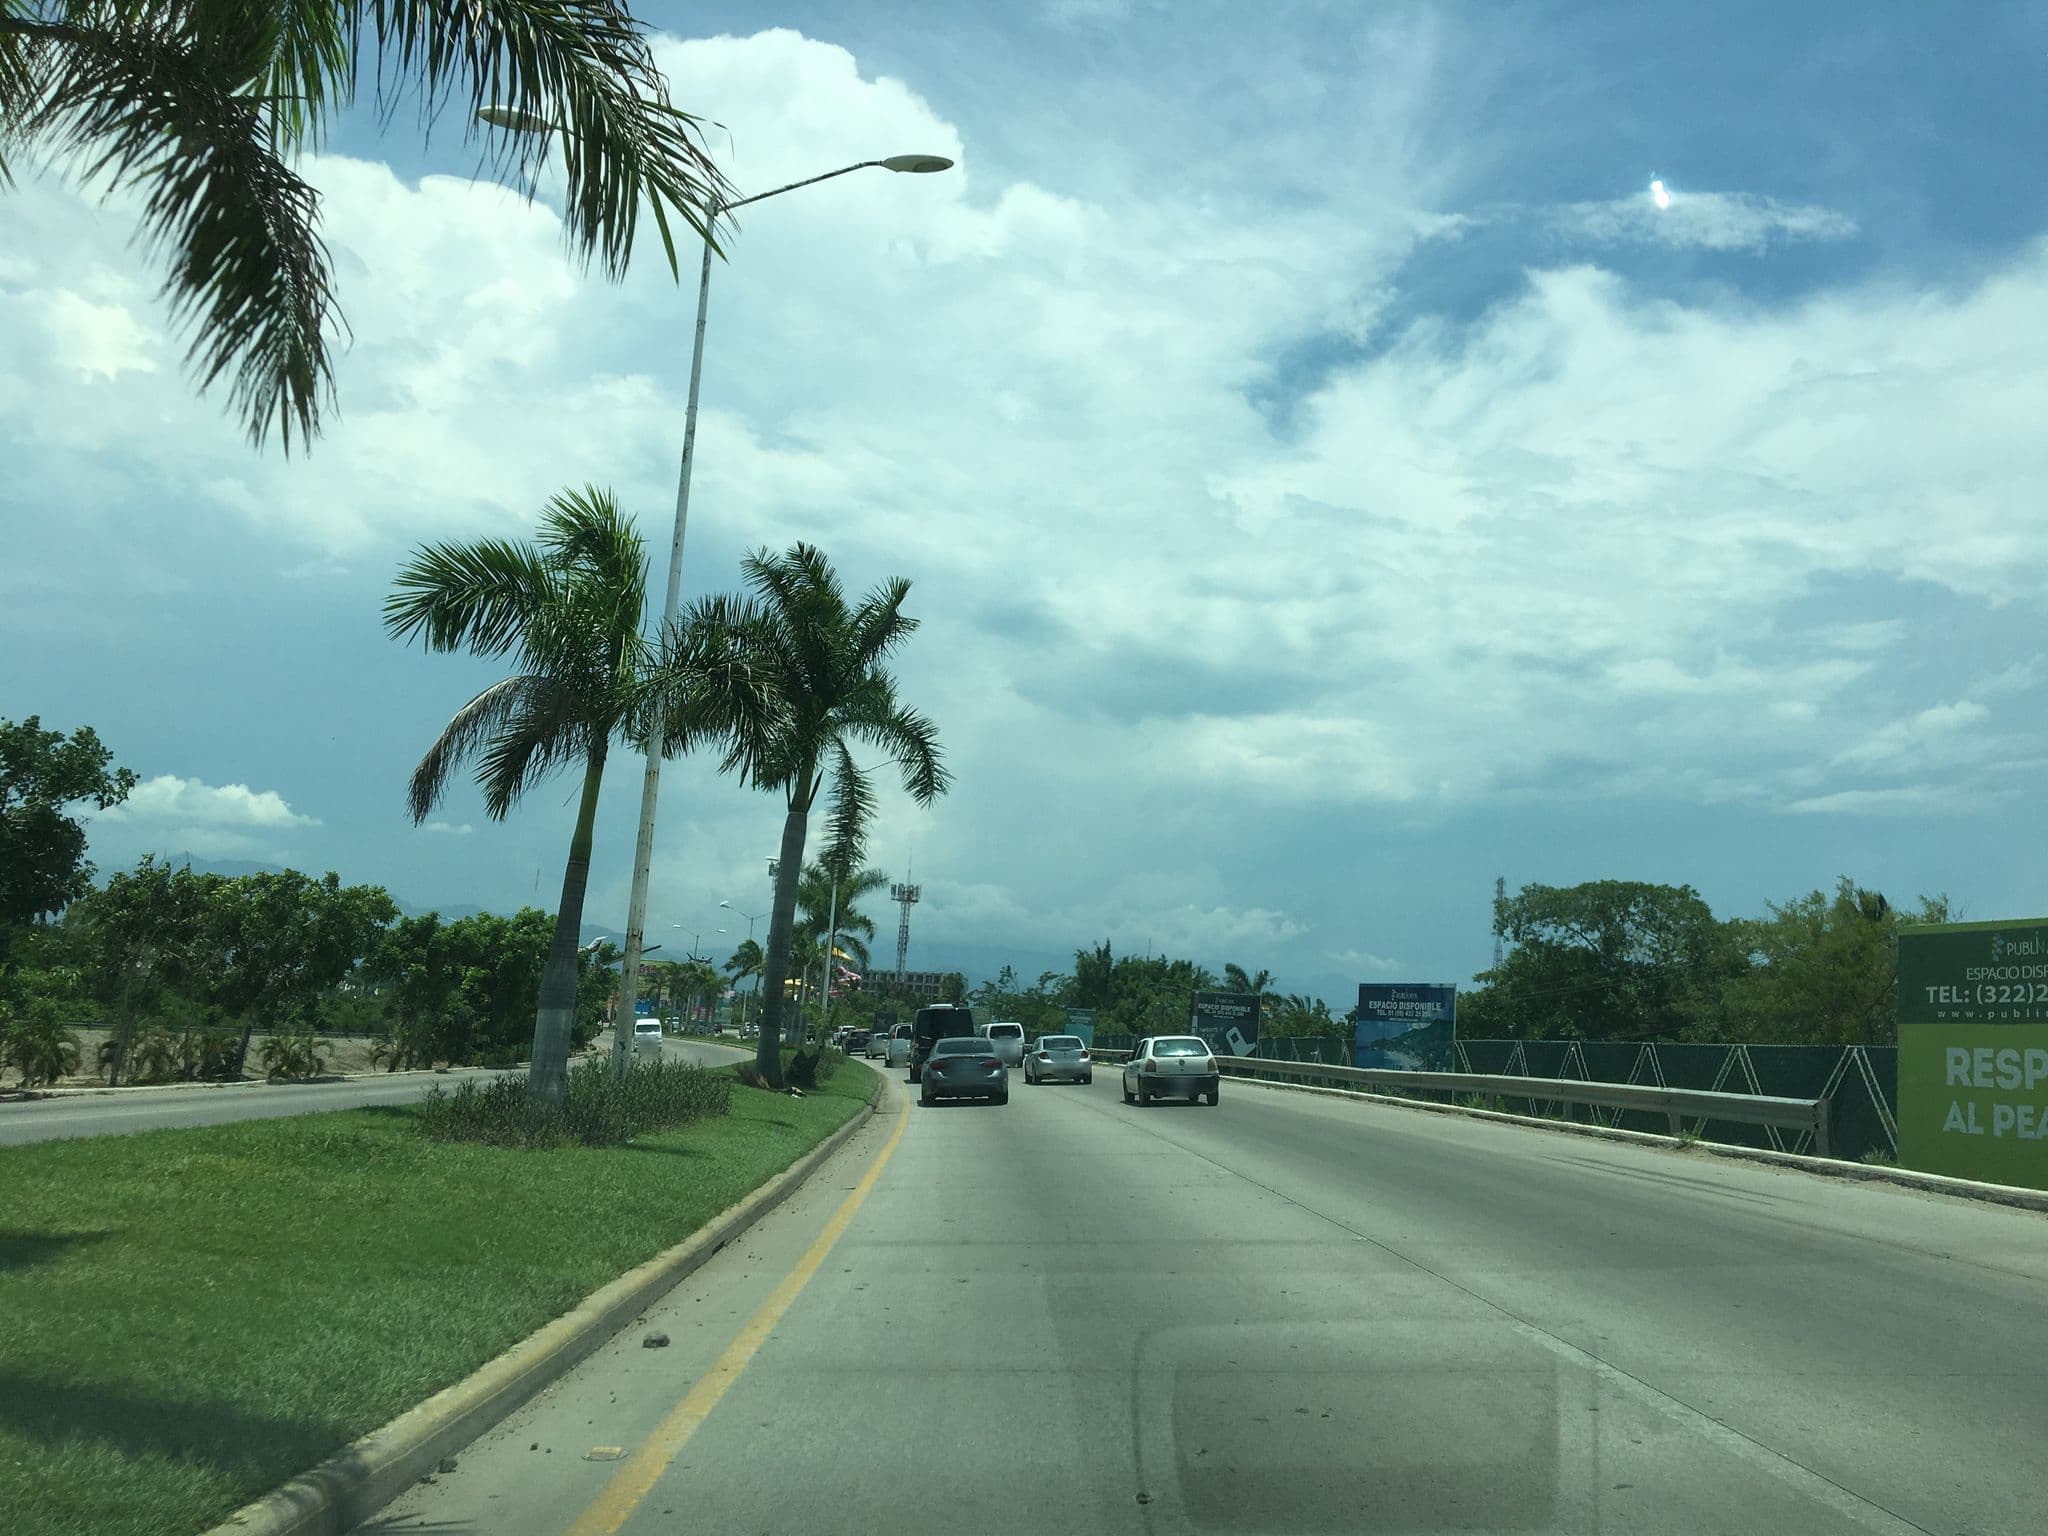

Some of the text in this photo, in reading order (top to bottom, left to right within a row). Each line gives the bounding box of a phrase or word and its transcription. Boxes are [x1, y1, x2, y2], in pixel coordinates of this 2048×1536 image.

[1966, 966, 2020, 981] ESPACIO
[1925, 985, 1970, 1004] TEL:
[1368, 1001, 1442, 1012] ESPACIO DISPONIBLE
[1945, 1047, 2048, 1090] RESP
[1943, 1100, 1985, 1135] AL
